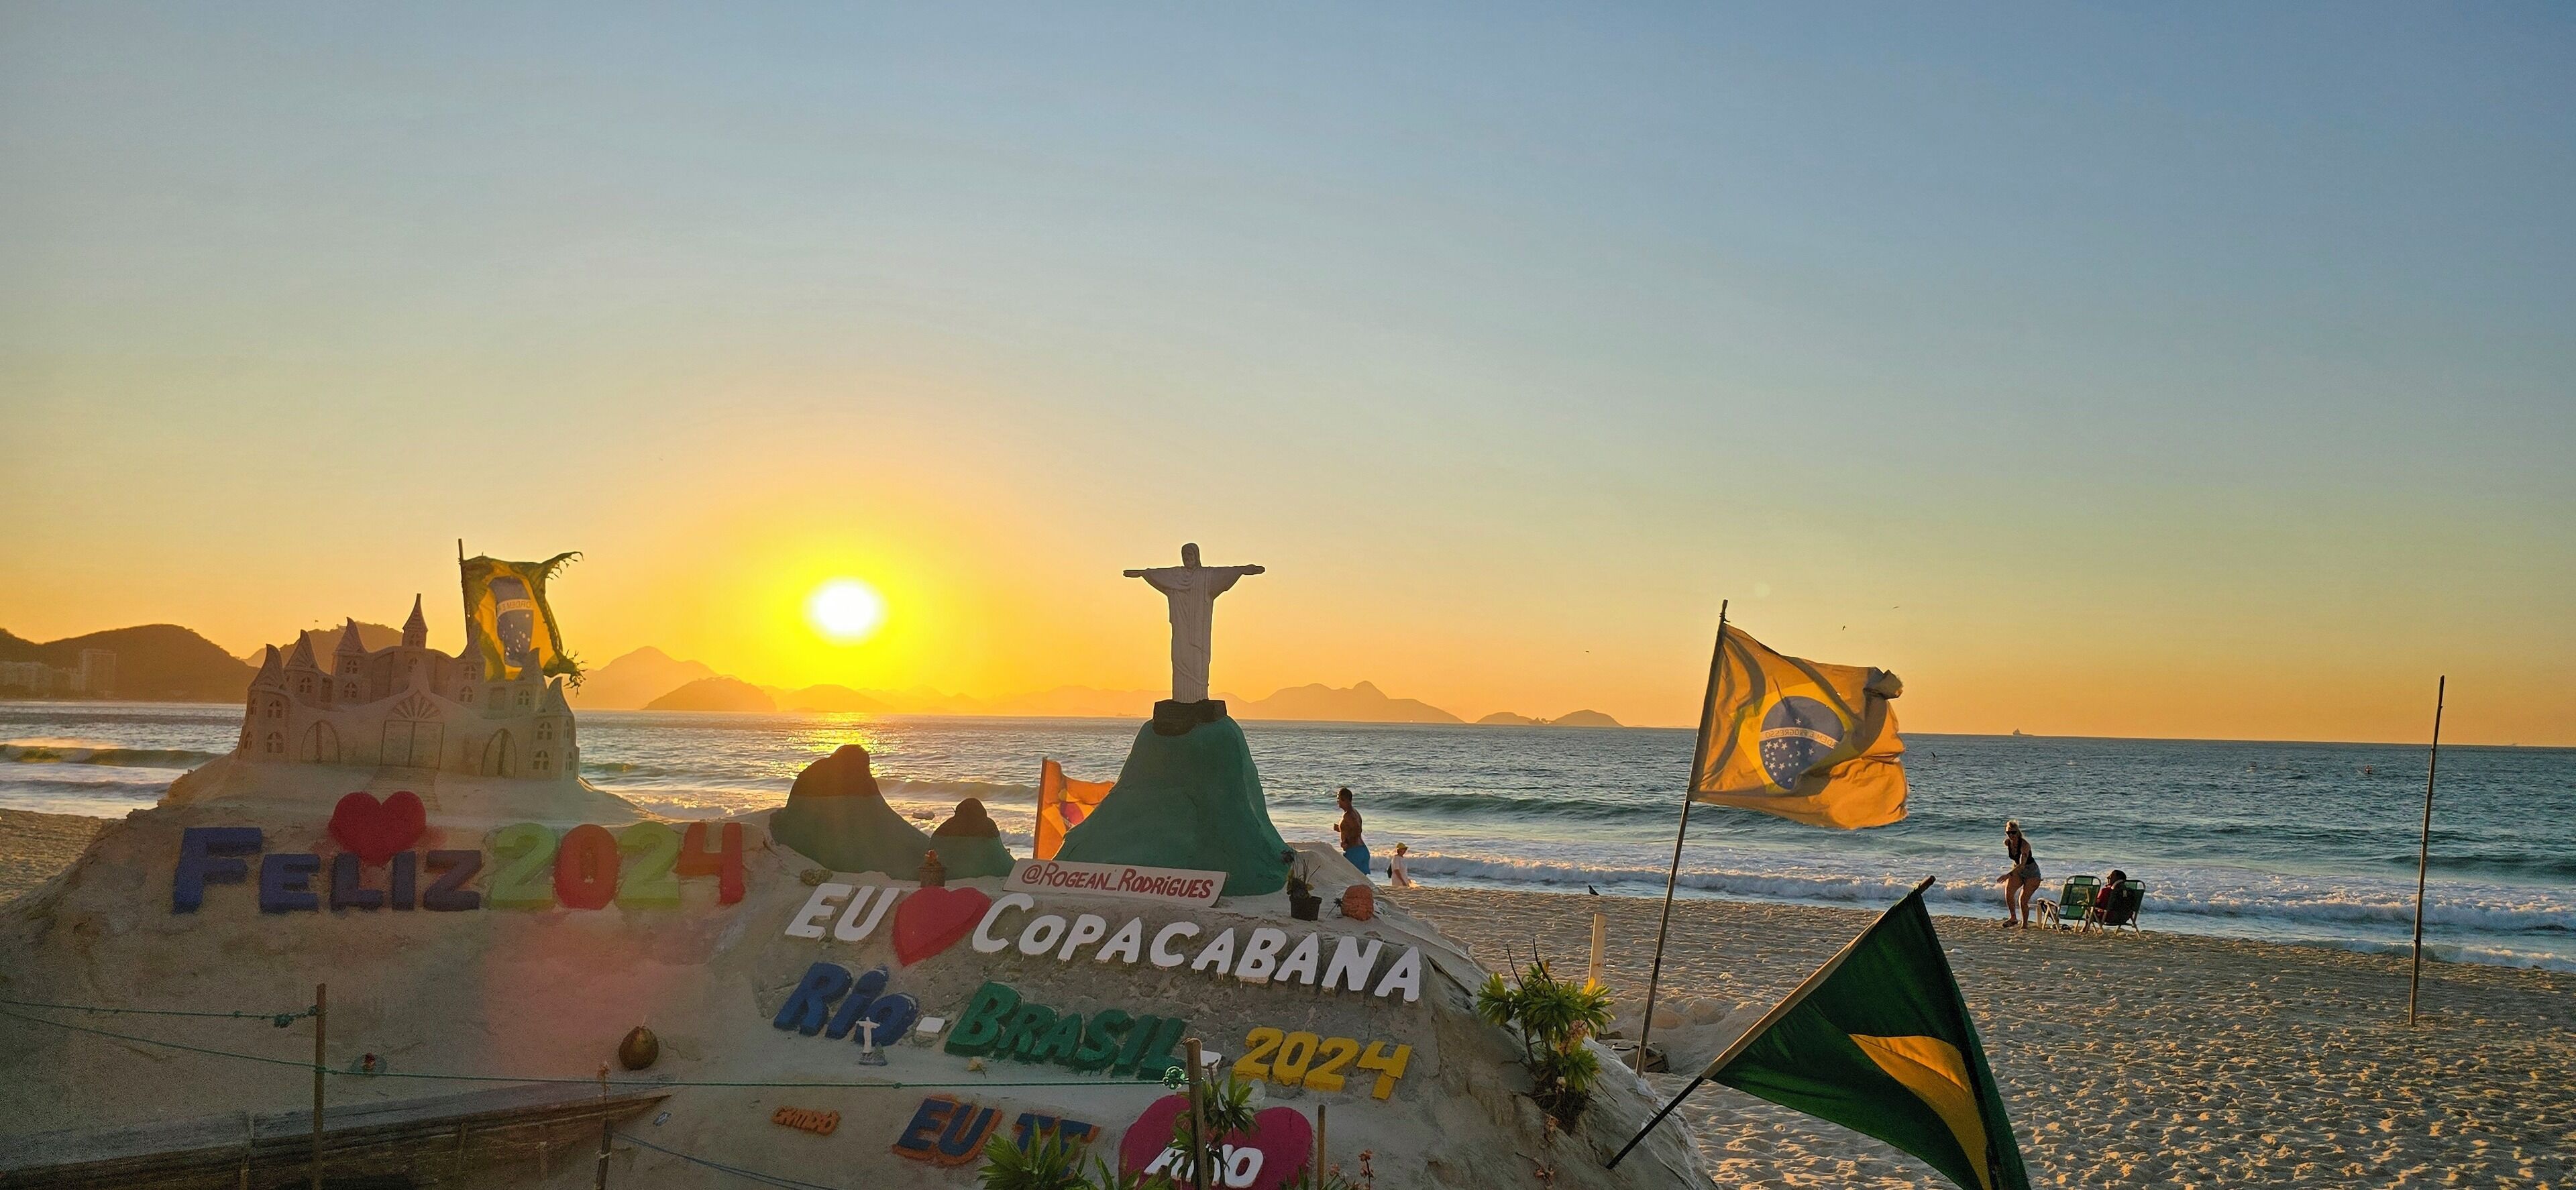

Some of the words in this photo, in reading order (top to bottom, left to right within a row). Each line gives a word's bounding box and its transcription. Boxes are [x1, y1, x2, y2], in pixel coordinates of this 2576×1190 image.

[173, 827, 482, 914] FELIZ
[488, 821, 745, 910] 2024
[785, 883, 901, 941] EU
[972, 893, 1421, 1002] COPACABANA
[944, 981, 1186, 1080] BRASIL
[1232, 1026, 1412, 1100] 2024
[894, 1097, 1000, 1164] EU
